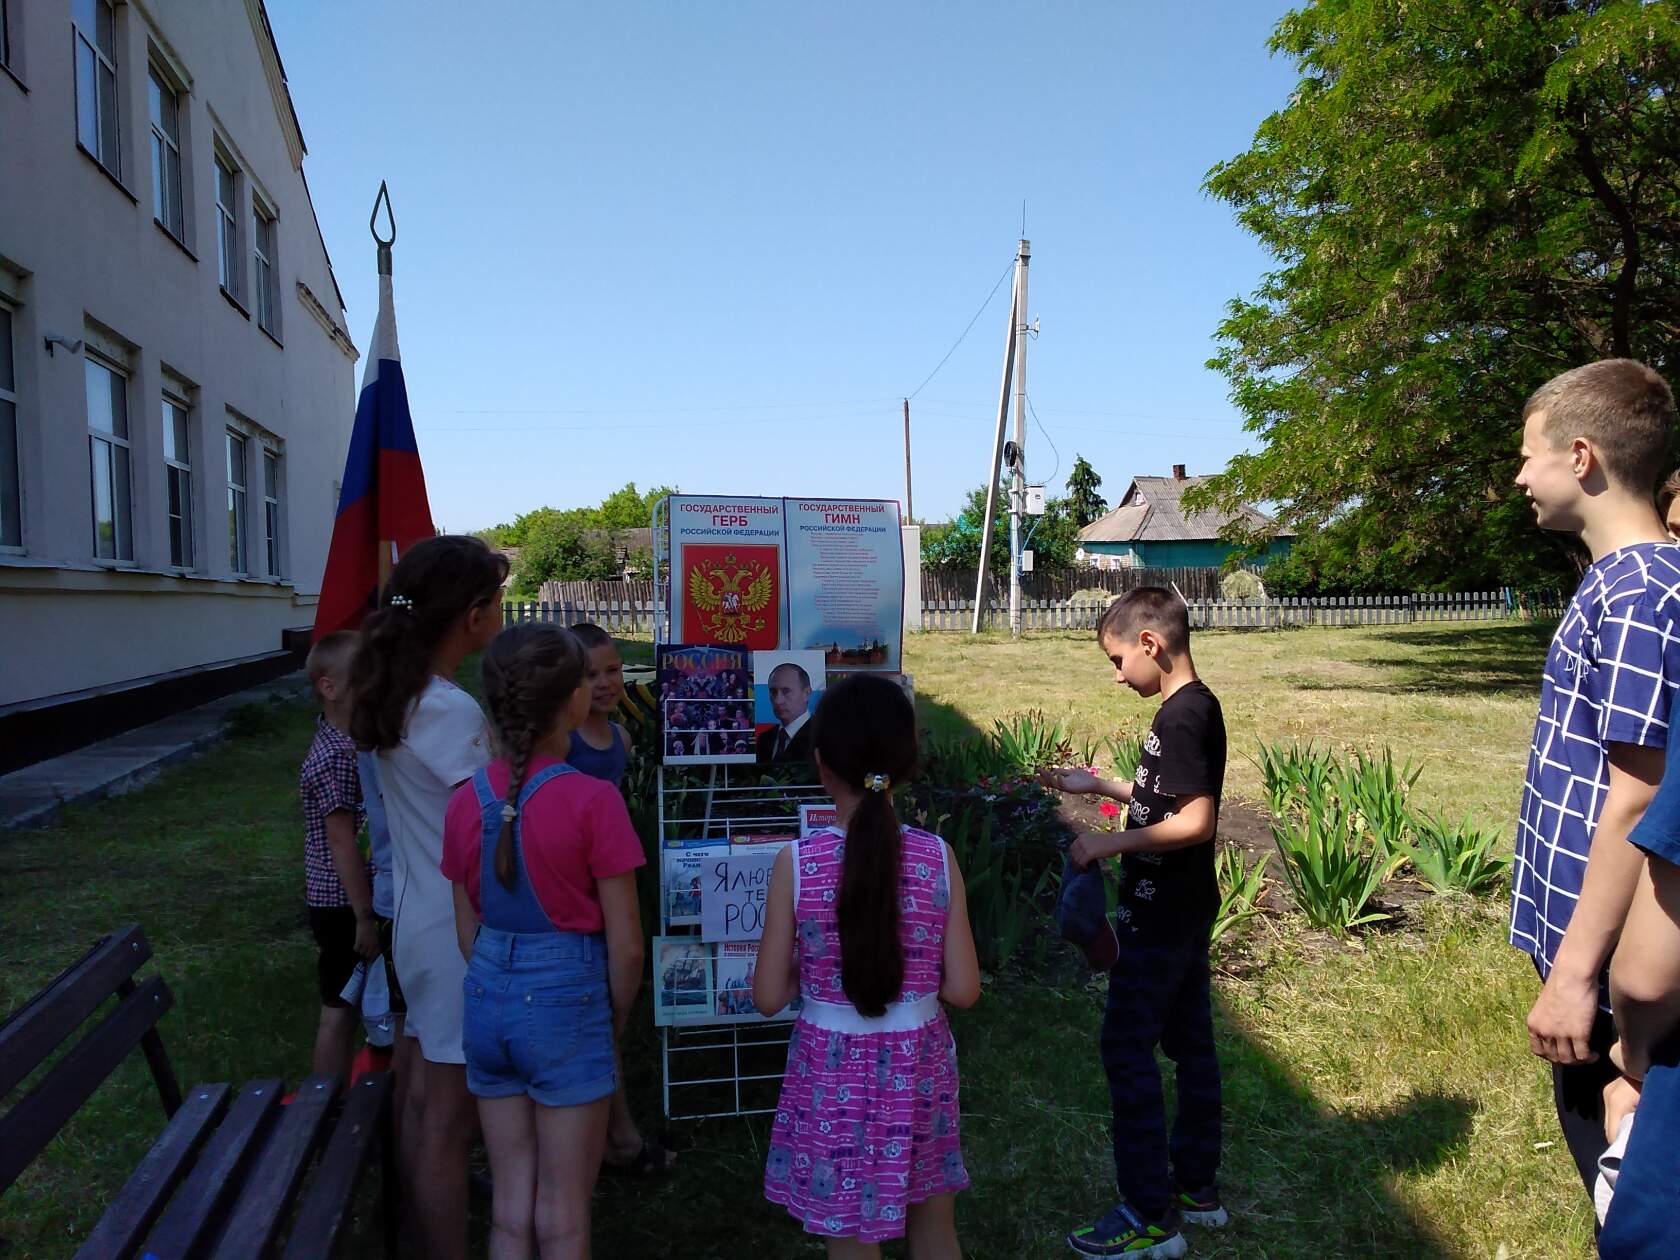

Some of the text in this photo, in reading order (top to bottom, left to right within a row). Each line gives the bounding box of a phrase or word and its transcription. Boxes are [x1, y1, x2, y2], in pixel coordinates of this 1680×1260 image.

[680, 504, 779, 514] ГОСУДАРСТВЕННЫЙ
[799, 503, 885, 513] ГОСУДАРСТВЕННЫЙ
[712, 515, 748, 527] ГЕРБ
[825, 513, 860, 524] ГИМН
[680, 528, 780, 537] РОССИЙСКОЙ ФЕДЕРАЦИИ
[800, 525, 886, 533] РОССИЙСКОЙ ФЕДЕРАЦИИ
[661, 653, 742, 670] РОССИЯ
[714, 862, 728, 892] Я
